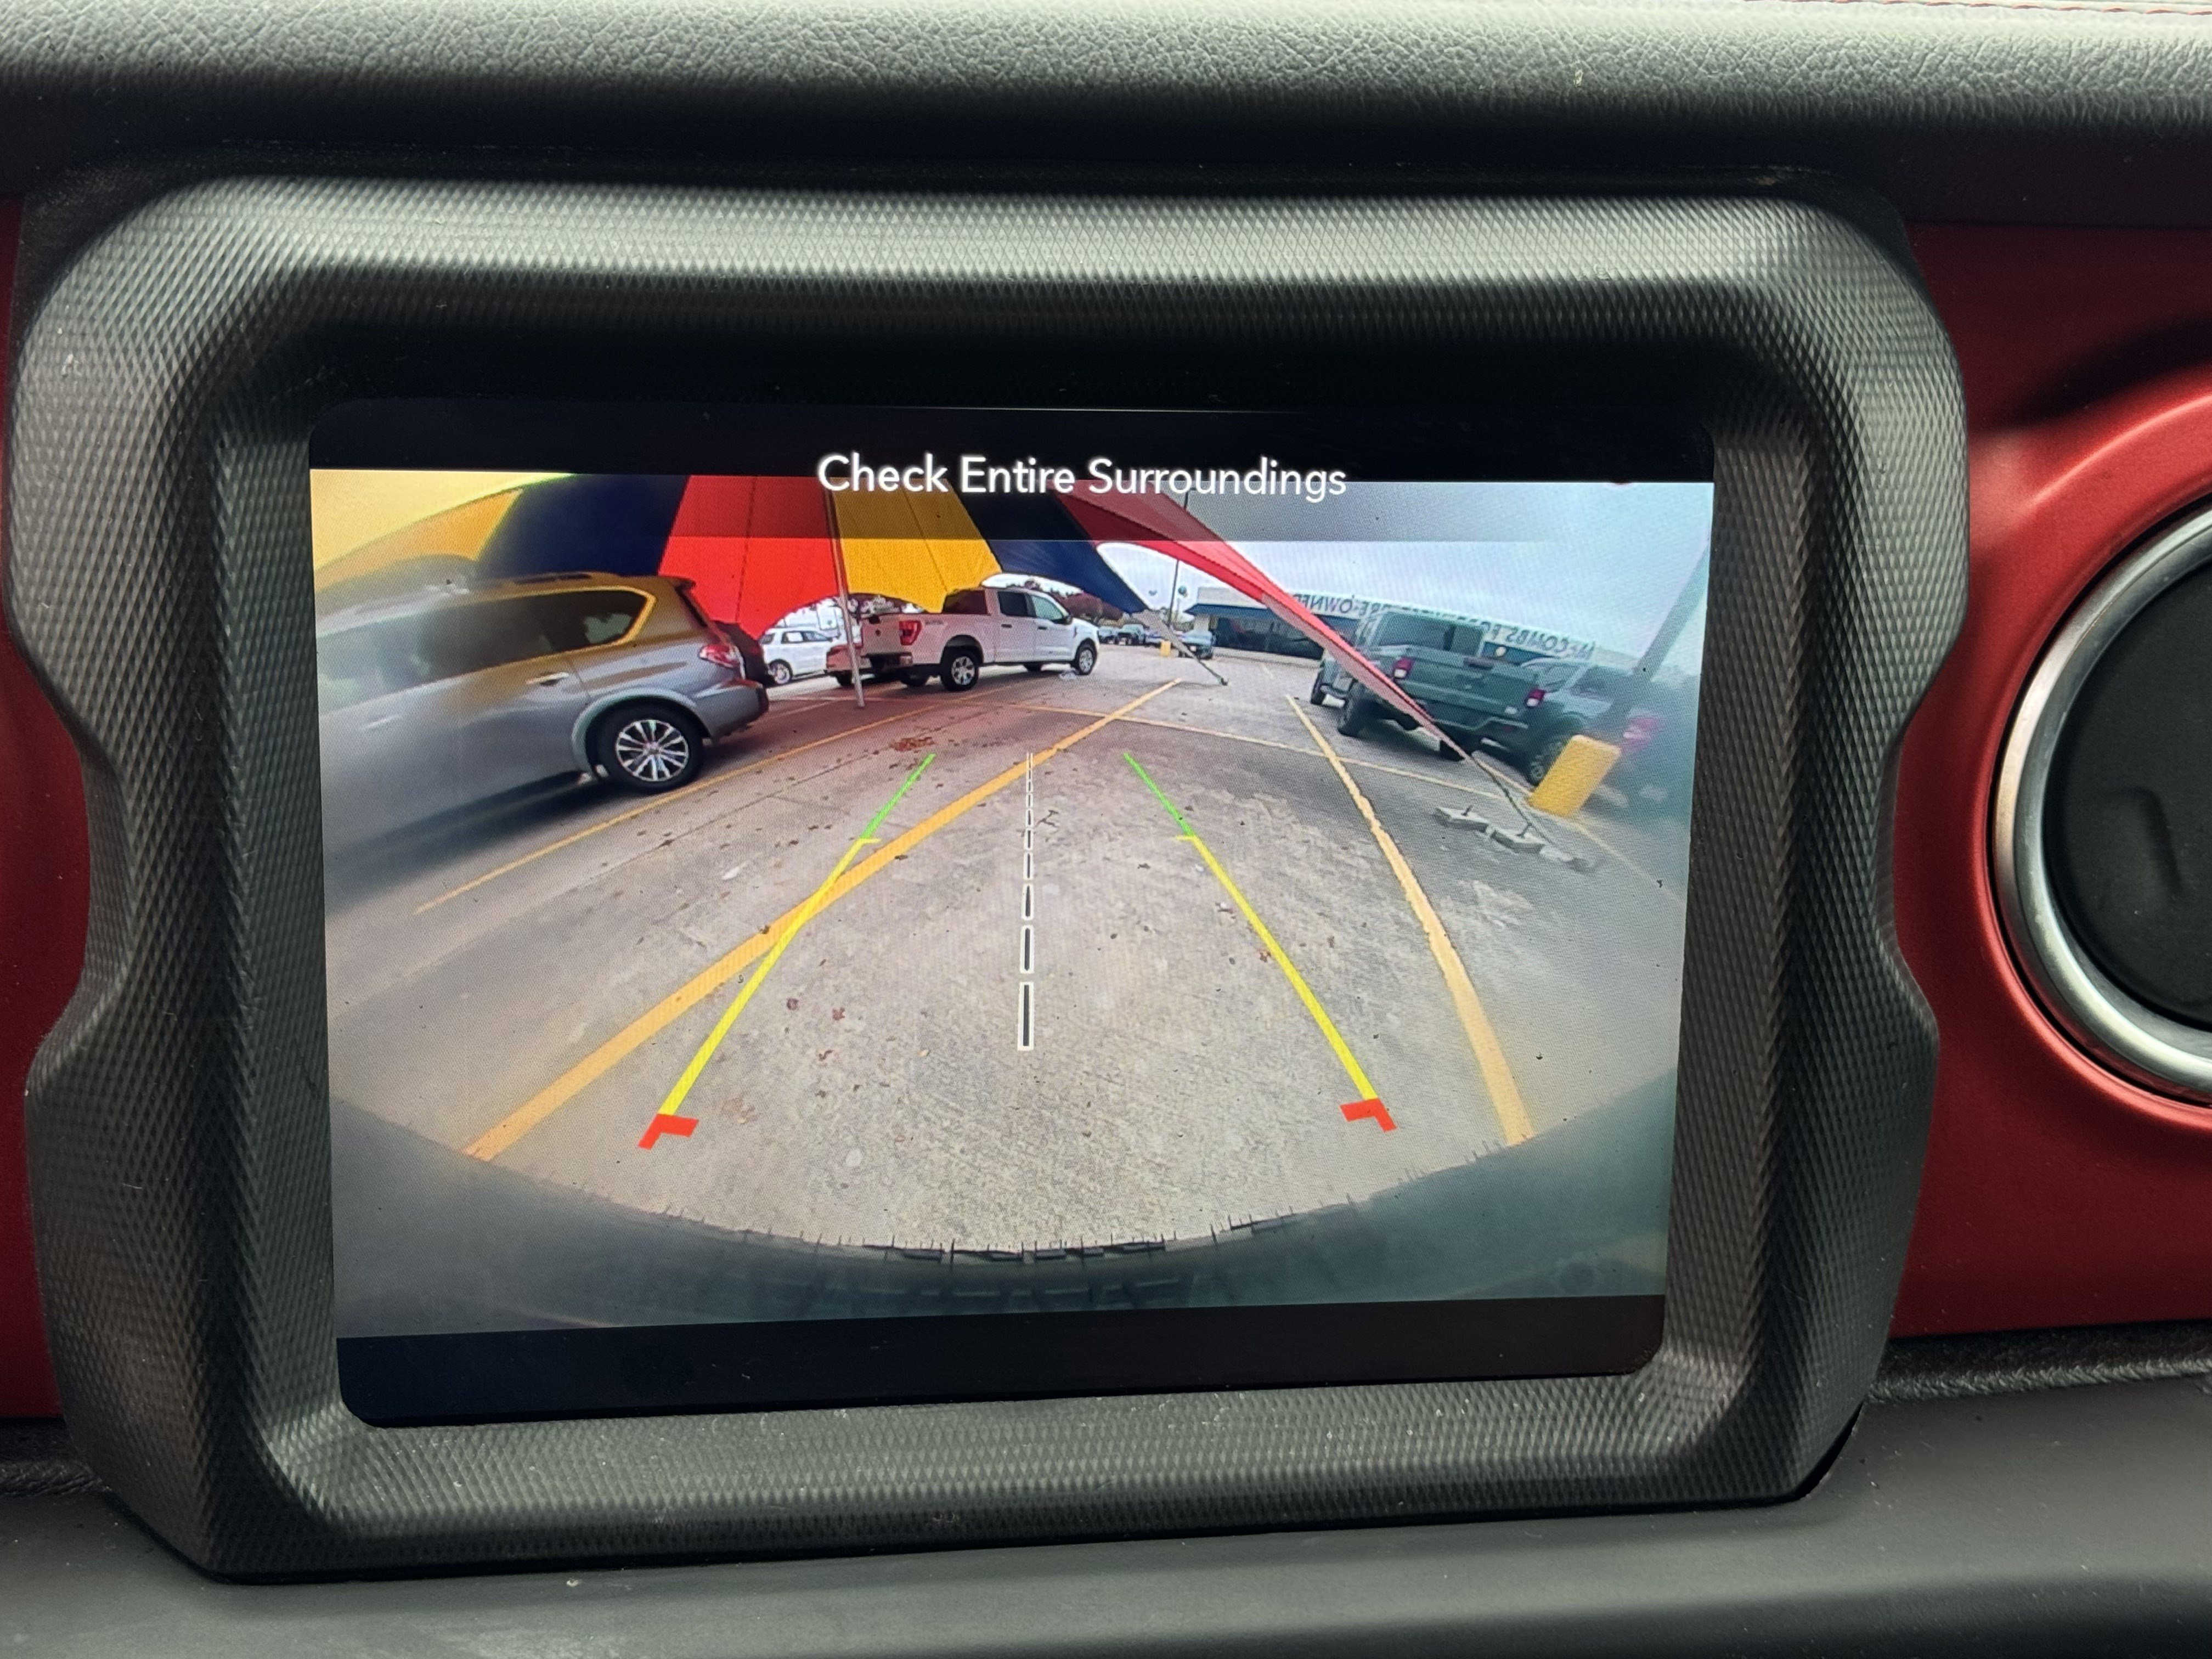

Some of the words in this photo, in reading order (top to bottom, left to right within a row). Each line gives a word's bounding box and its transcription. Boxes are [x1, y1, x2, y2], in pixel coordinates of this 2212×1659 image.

[817, 452, 949, 493] Check
[961, 455, 1076, 494] Entire
[1088, 455, 1347, 503] Surroundings
